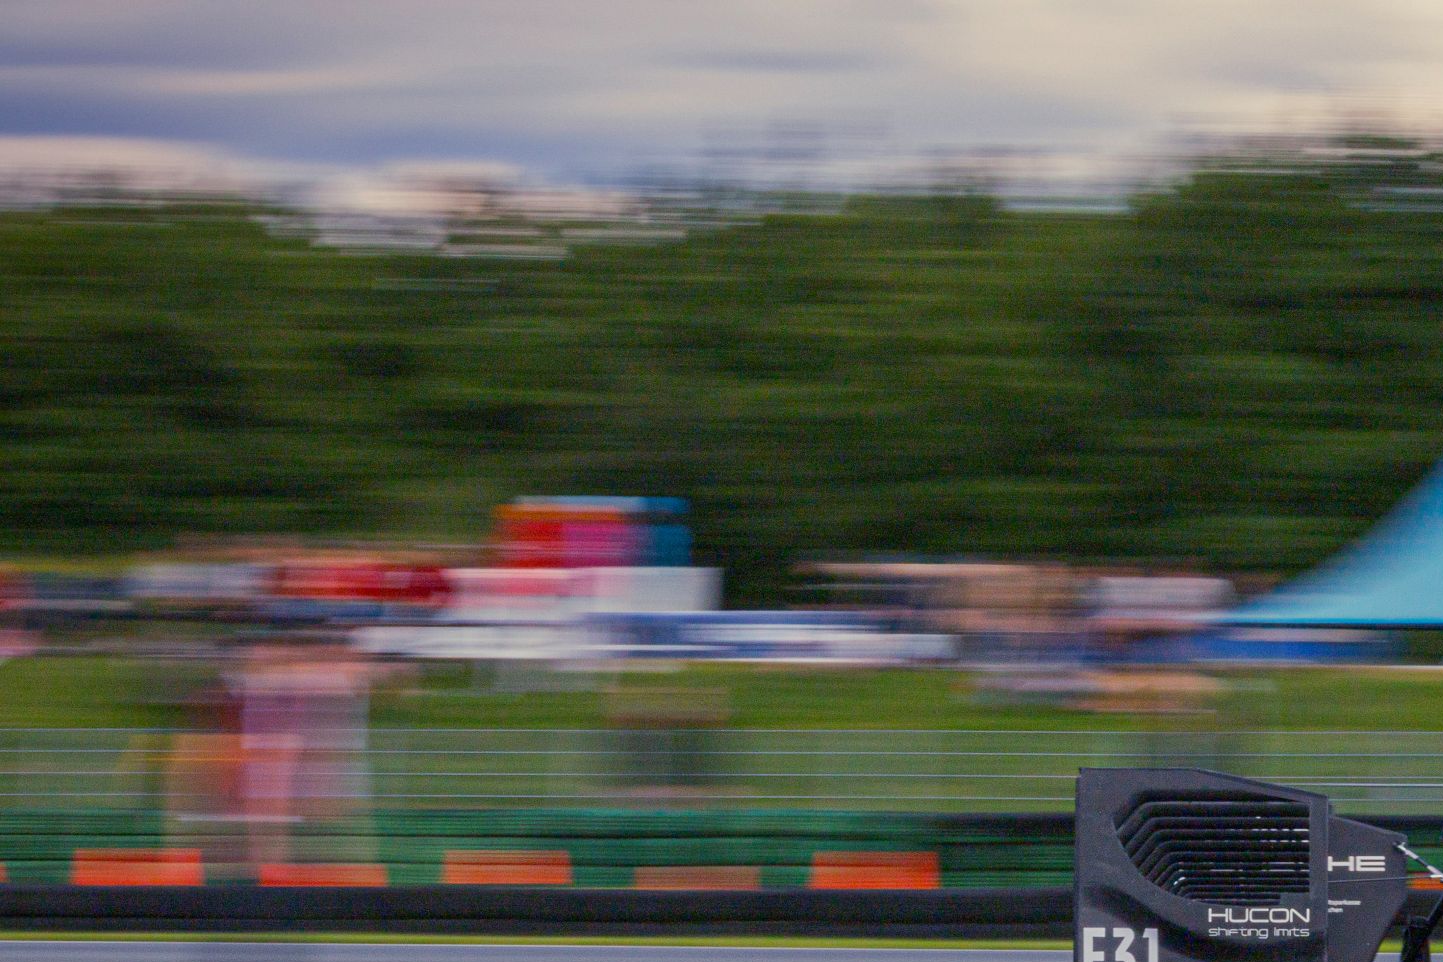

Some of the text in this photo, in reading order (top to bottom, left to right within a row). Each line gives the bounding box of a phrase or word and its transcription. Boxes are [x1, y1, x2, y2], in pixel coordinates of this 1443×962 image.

[1208, 908, 1310, 923] HUCON
[1208, 927, 1310, 939] shifting limits
